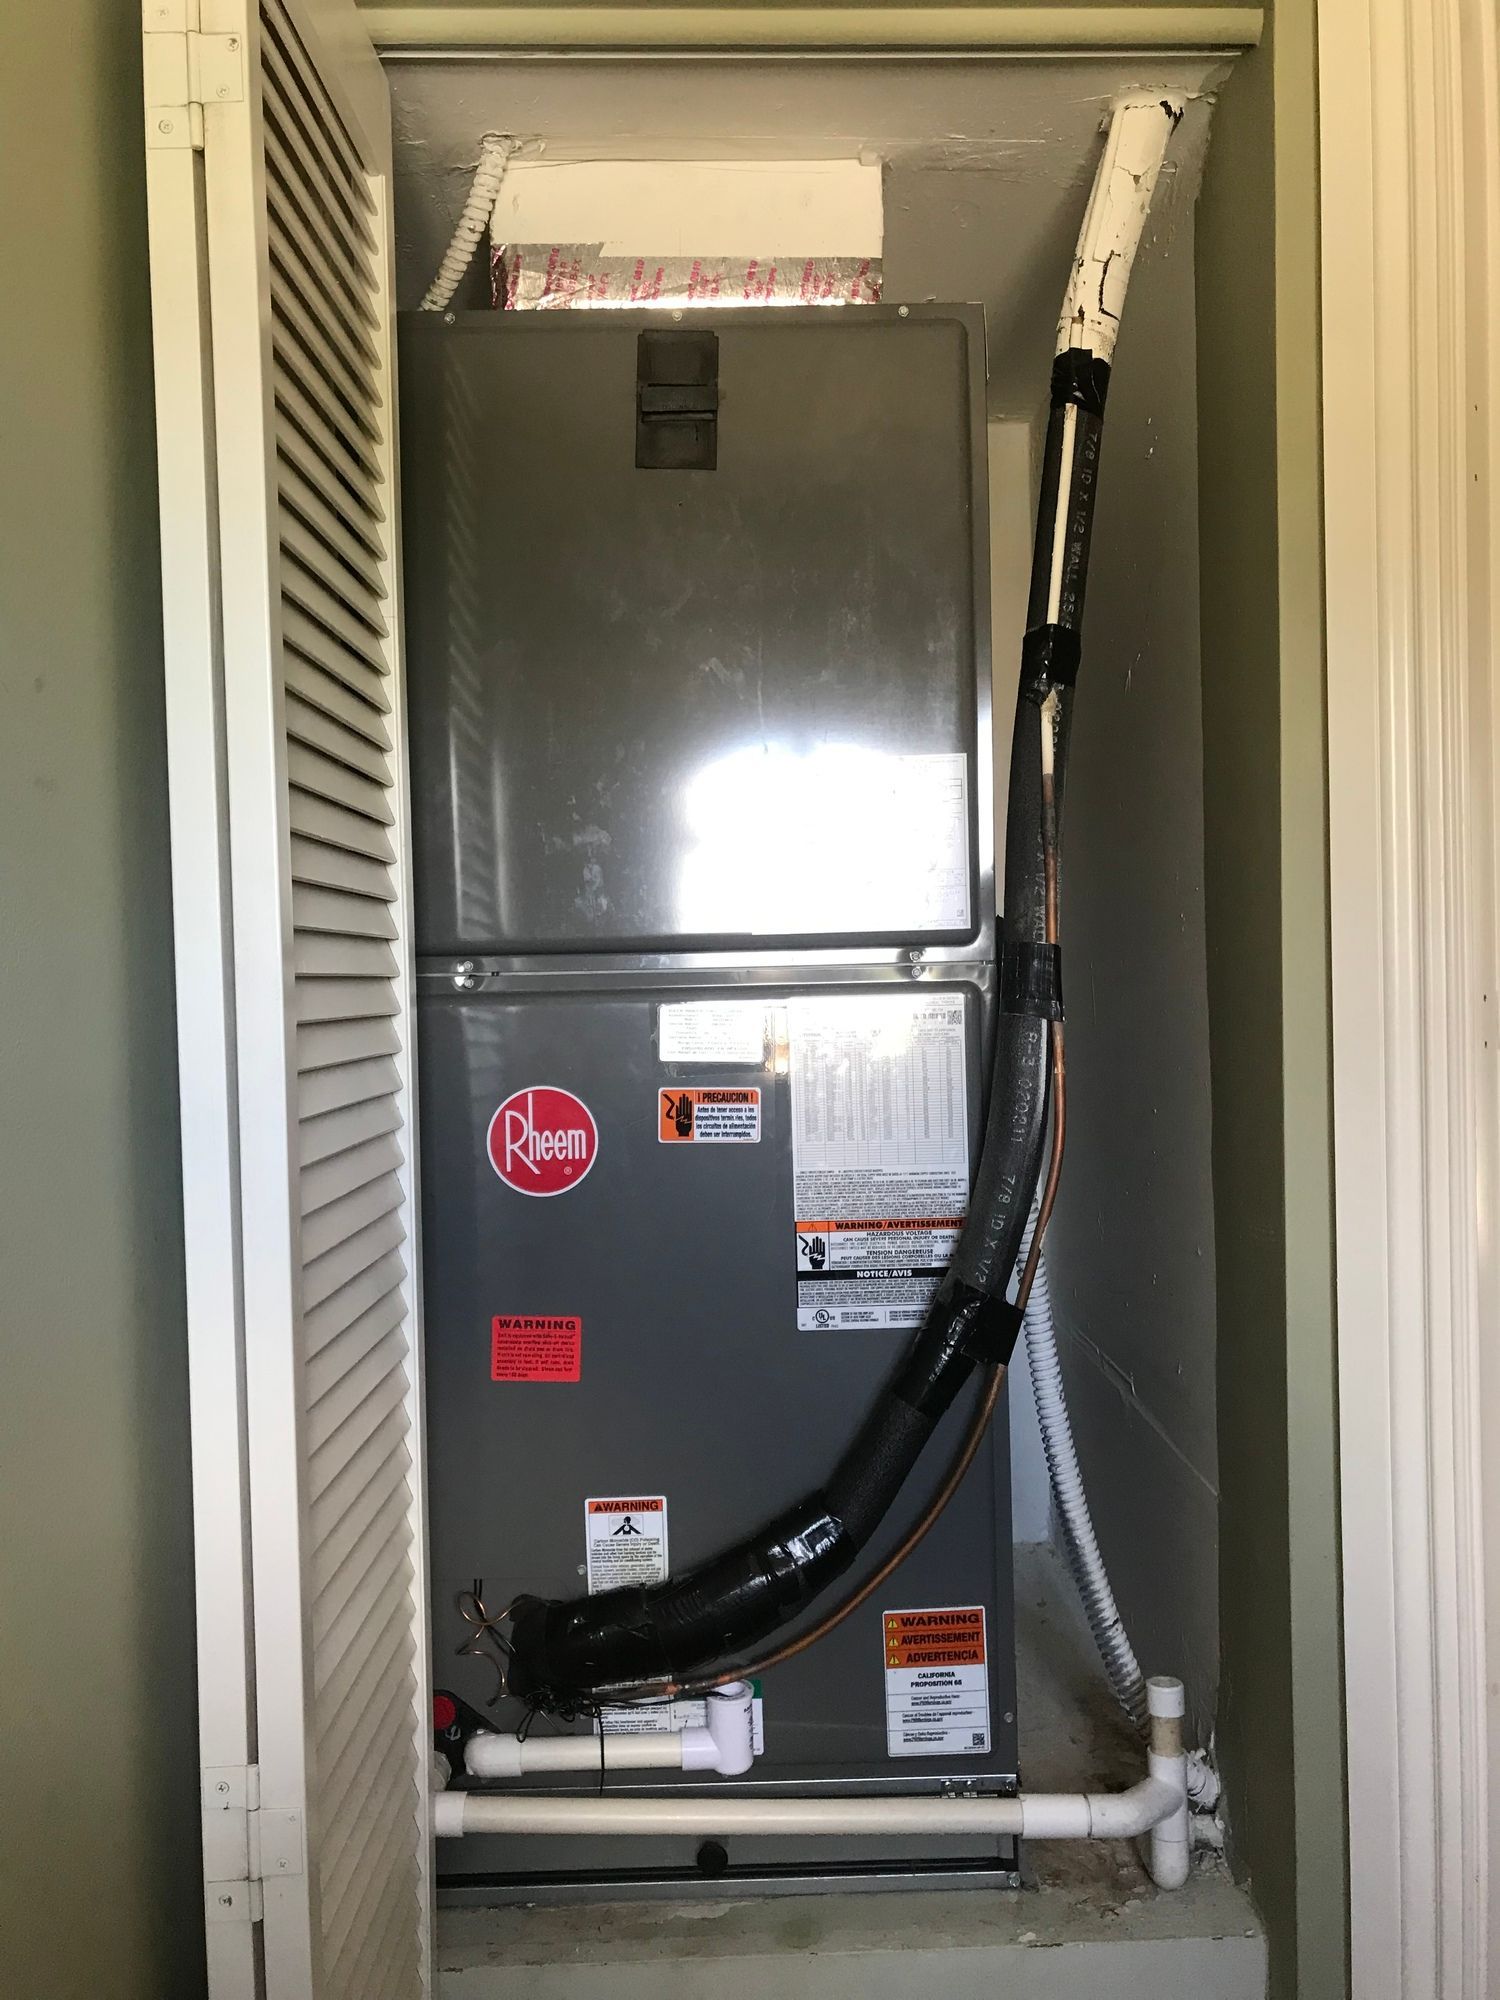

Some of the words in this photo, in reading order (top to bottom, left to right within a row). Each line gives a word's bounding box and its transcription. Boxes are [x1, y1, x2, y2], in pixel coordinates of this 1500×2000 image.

[1085, 432, 1098, 460] 7/8
[1081, 470, 1093, 485] ID
[1073, 510, 1087, 534] 1/2
[1066, 541, 1082, 584] WALL
[702, 1092, 749, 1103] PRECAUCION
[505, 1092, 587, 1175] Rheem
[998, 1173, 1016, 1206] 7/8
[834, 1219, 963, 1230] WARNING/AVERTISSEMENT
[856, 1270, 912, 1278] NOTICE/AVIS
[498, 1319, 576, 1330] WARNING
[603, 1501, 658, 1511] WARNING
[901, 1614, 979, 1627] WARNING
[902, 1632, 980, 1645] AVERTISSEMENT
[906, 1650, 978, 1663] ADVERTENCIA
